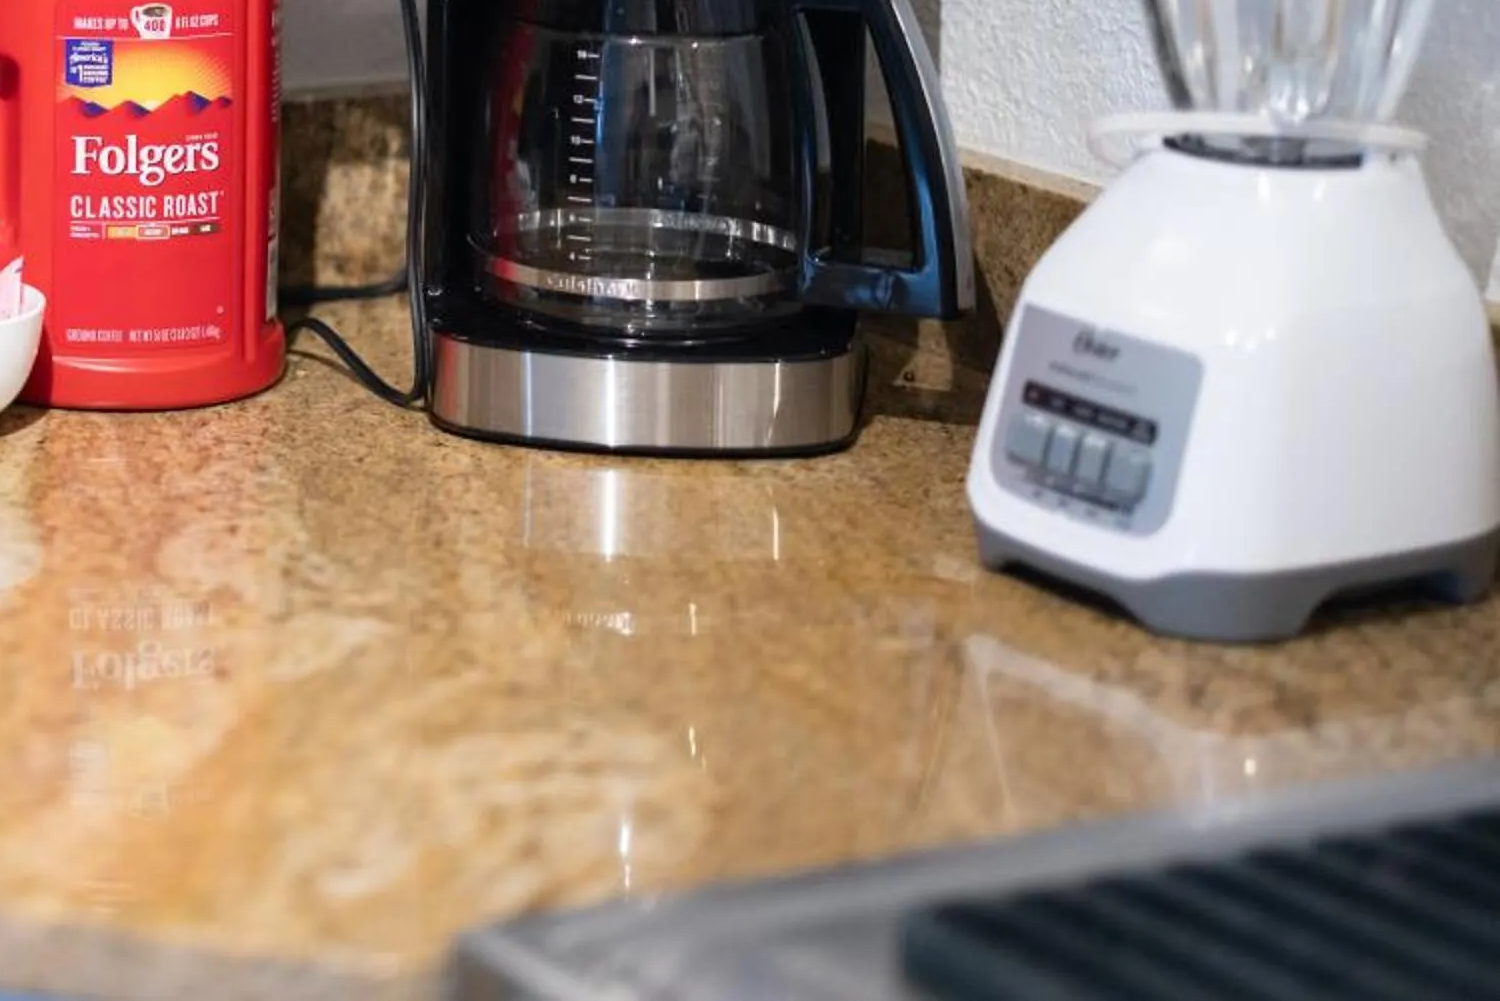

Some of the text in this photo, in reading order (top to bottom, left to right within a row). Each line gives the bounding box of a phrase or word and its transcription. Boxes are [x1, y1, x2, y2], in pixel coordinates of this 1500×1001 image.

[70, 134, 221, 187] Folgers
[69, 190, 219, 219] CLASSIC ROAST
